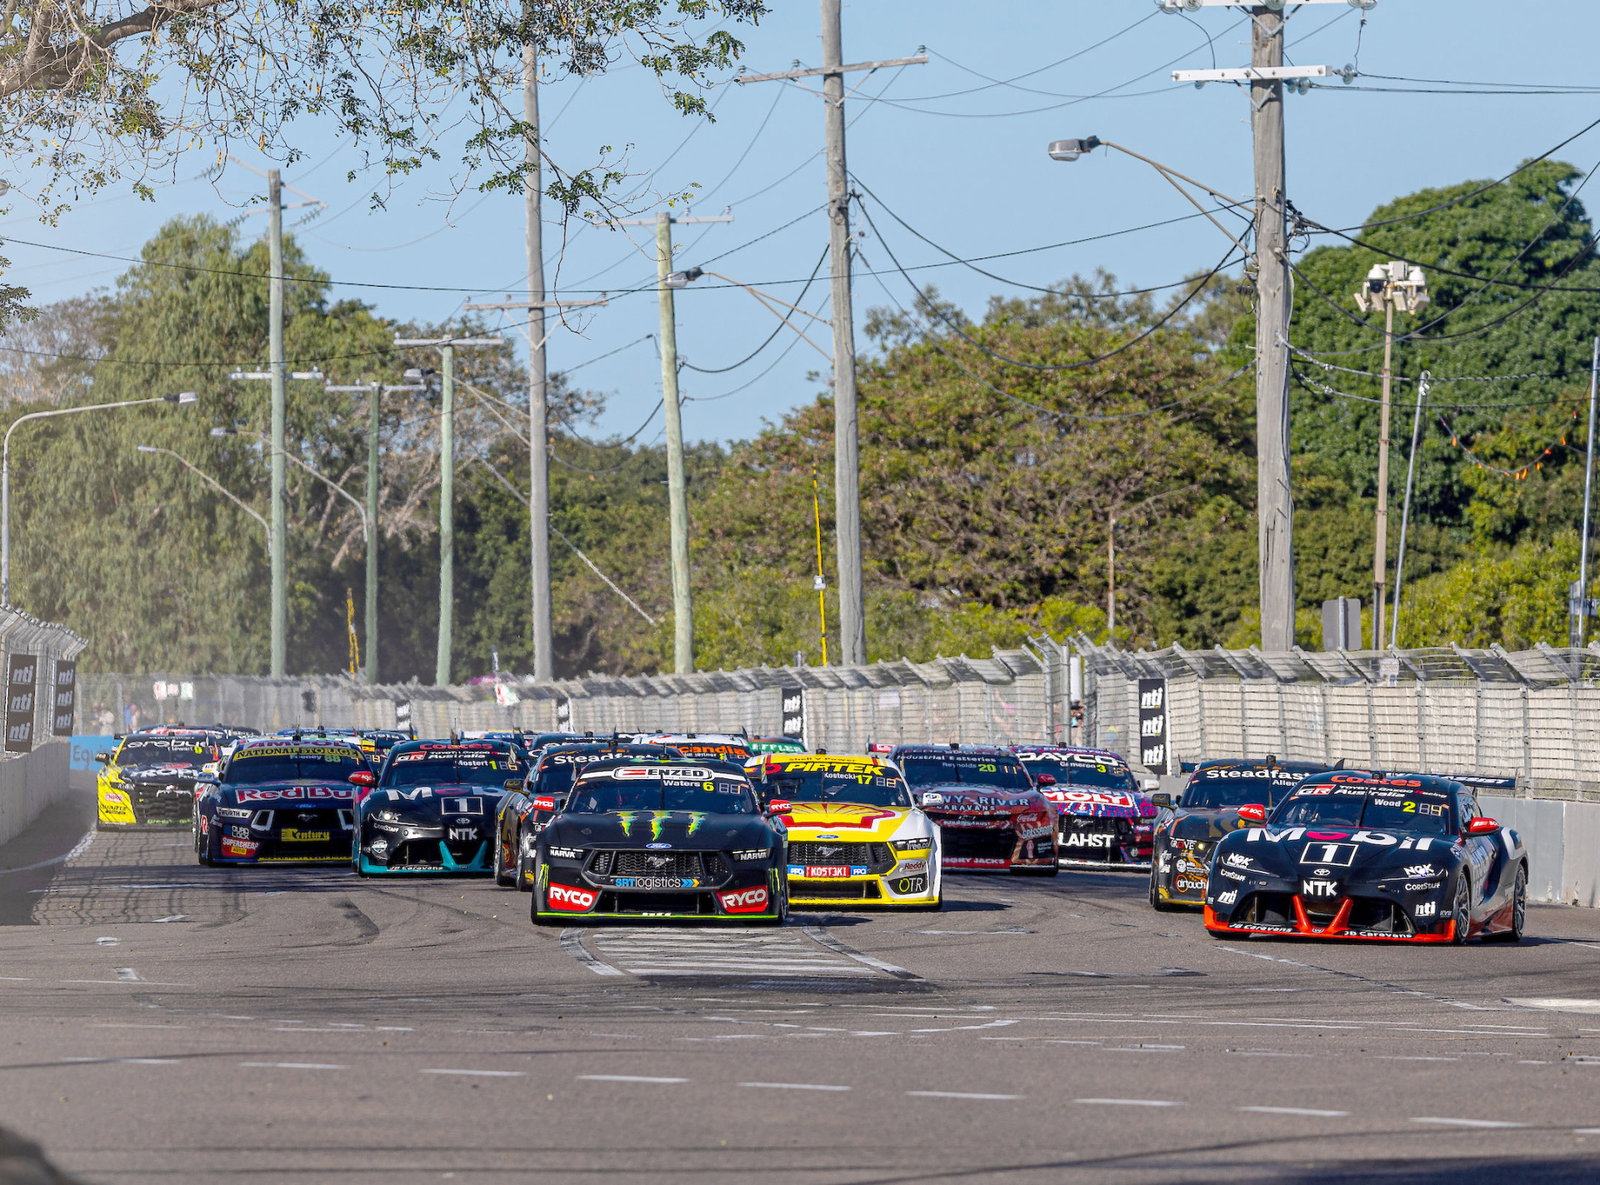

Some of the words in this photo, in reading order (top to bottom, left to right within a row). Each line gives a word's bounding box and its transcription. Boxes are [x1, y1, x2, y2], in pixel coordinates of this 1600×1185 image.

[12, 665, 34, 683] nti
[58, 669, 74, 684] nti
[10, 693, 32, 711] nti
[58, 690, 72, 706] nti
[1141, 687, 1163, 707] nti
[56, 714, 72, 728] nti
[1142, 714, 1164, 735] nti
[9, 722, 30, 740] nti
[669, 745, 745, 756] candia
[1144, 744, 1164, 764] nti
[490, 760, 497, 770] 1
[1015, 752, 1119, 766] DAYCO
[648, 769, 704, 777] ENZED
[785, 762, 885, 776] PIRTEK
[978, 764, 996, 772] 20
[1096, 764, 1106, 773] 3
[1206, 769, 1310, 780] Steadfast
[824, 772, 856, 780] Kostecki
[856, 774, 873, 784] 17
[1331, 775, 1422, 787] Coates
[702, 782, 714, 792] 6
[1298, 786, 1331, 795] GR
[236, 787, 304, 803] Red
[308, 787, 352, 799] Bu
[1043, 791, 1126, 804] MOLY
[1334, 790, 1405, 798] Australia
[454, 800, 468, 812] 1
[980, 796, 1030, 806] RIVER
[1374, 798, 1401, 807] Wood
[1402, 802, 1416, 813] 2
[290, 829, 330, 841] Century
[450, 828, 478, 841] NTK
[1246, 828, 1434, 851] Mobil
[550, 850, 576, 858] NARVA
[741, 852, 767, 860] NARVA
[1228, 853, 1254, 866] NGK
[1318, 844, 1338, 862] 1
[905, 862, 924, 870] Reddy
[1404, 864, 1434, 876] NGK
[899, 878, 924, 892] OTR
[1178, 879, 1206, 889] airtouch
[1303, 880, 1338, 896] NTK
[550, 887, 594, 907] RYCO
[722, 889, 766, 908] RYCO
[1218, 889, 1238, 904] nti
[1414, 902, 1436, 916] nti
[1244, 924, 1293, 932] Caravans
